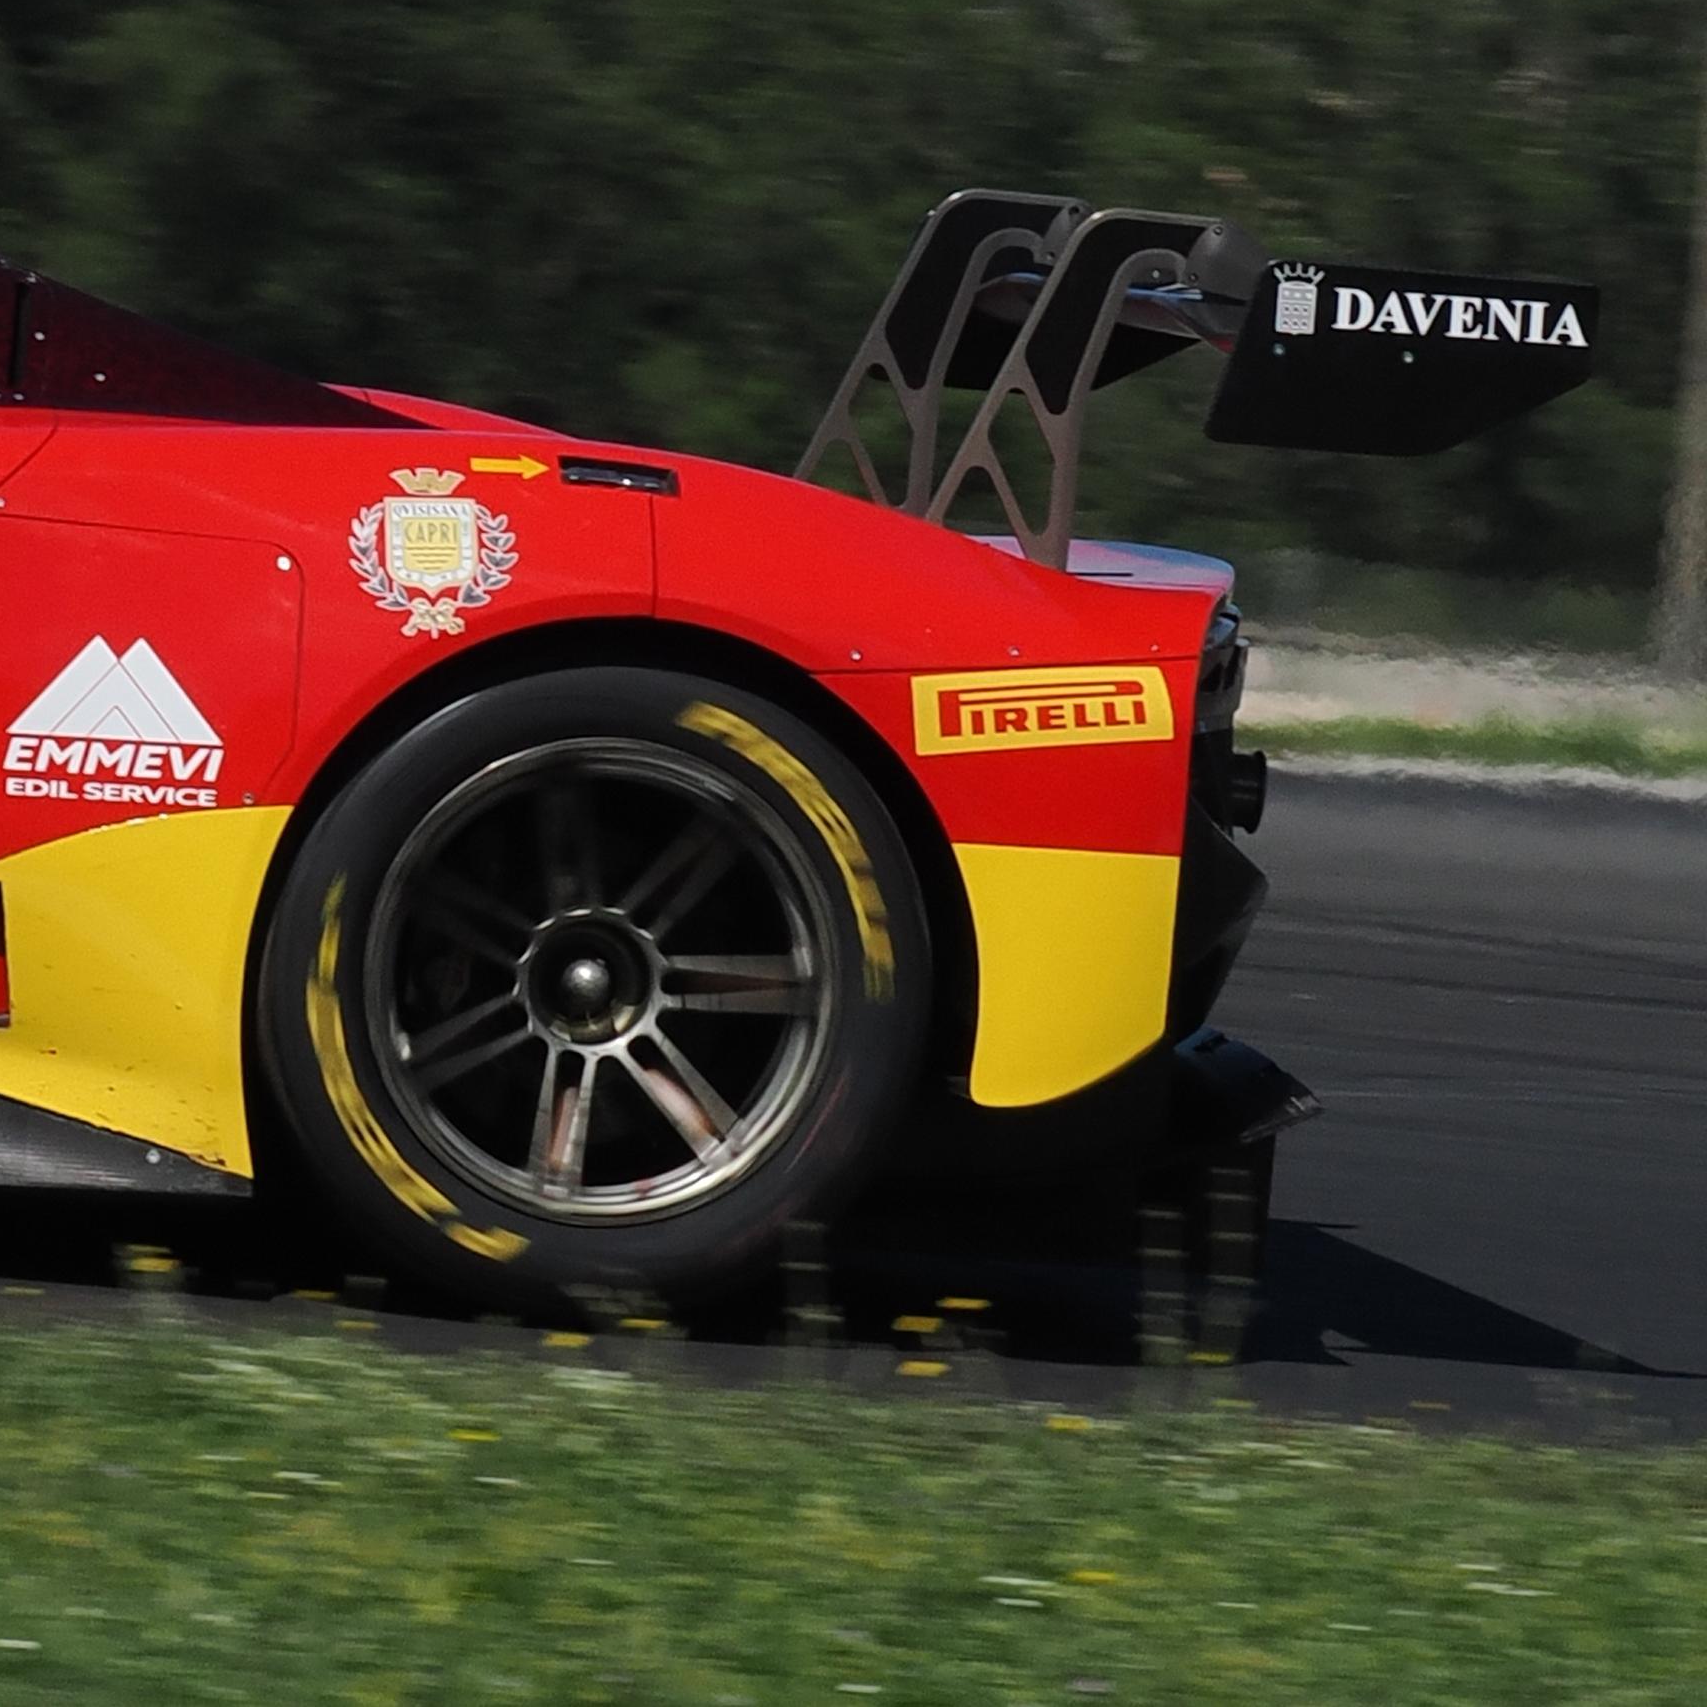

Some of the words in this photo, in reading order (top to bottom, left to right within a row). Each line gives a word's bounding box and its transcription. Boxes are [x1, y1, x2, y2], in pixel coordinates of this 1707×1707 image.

[1331, 286, 1589, 347] DAVENIA
[404, 521, 458, 542] CAPRI
[938, 681, 1147, 738] PIRELLI
[3, 736, 225, 782] EMMEVI
[5, 777, 79, 800] EDIL
[82, 782, 218, 807] SERVICE
